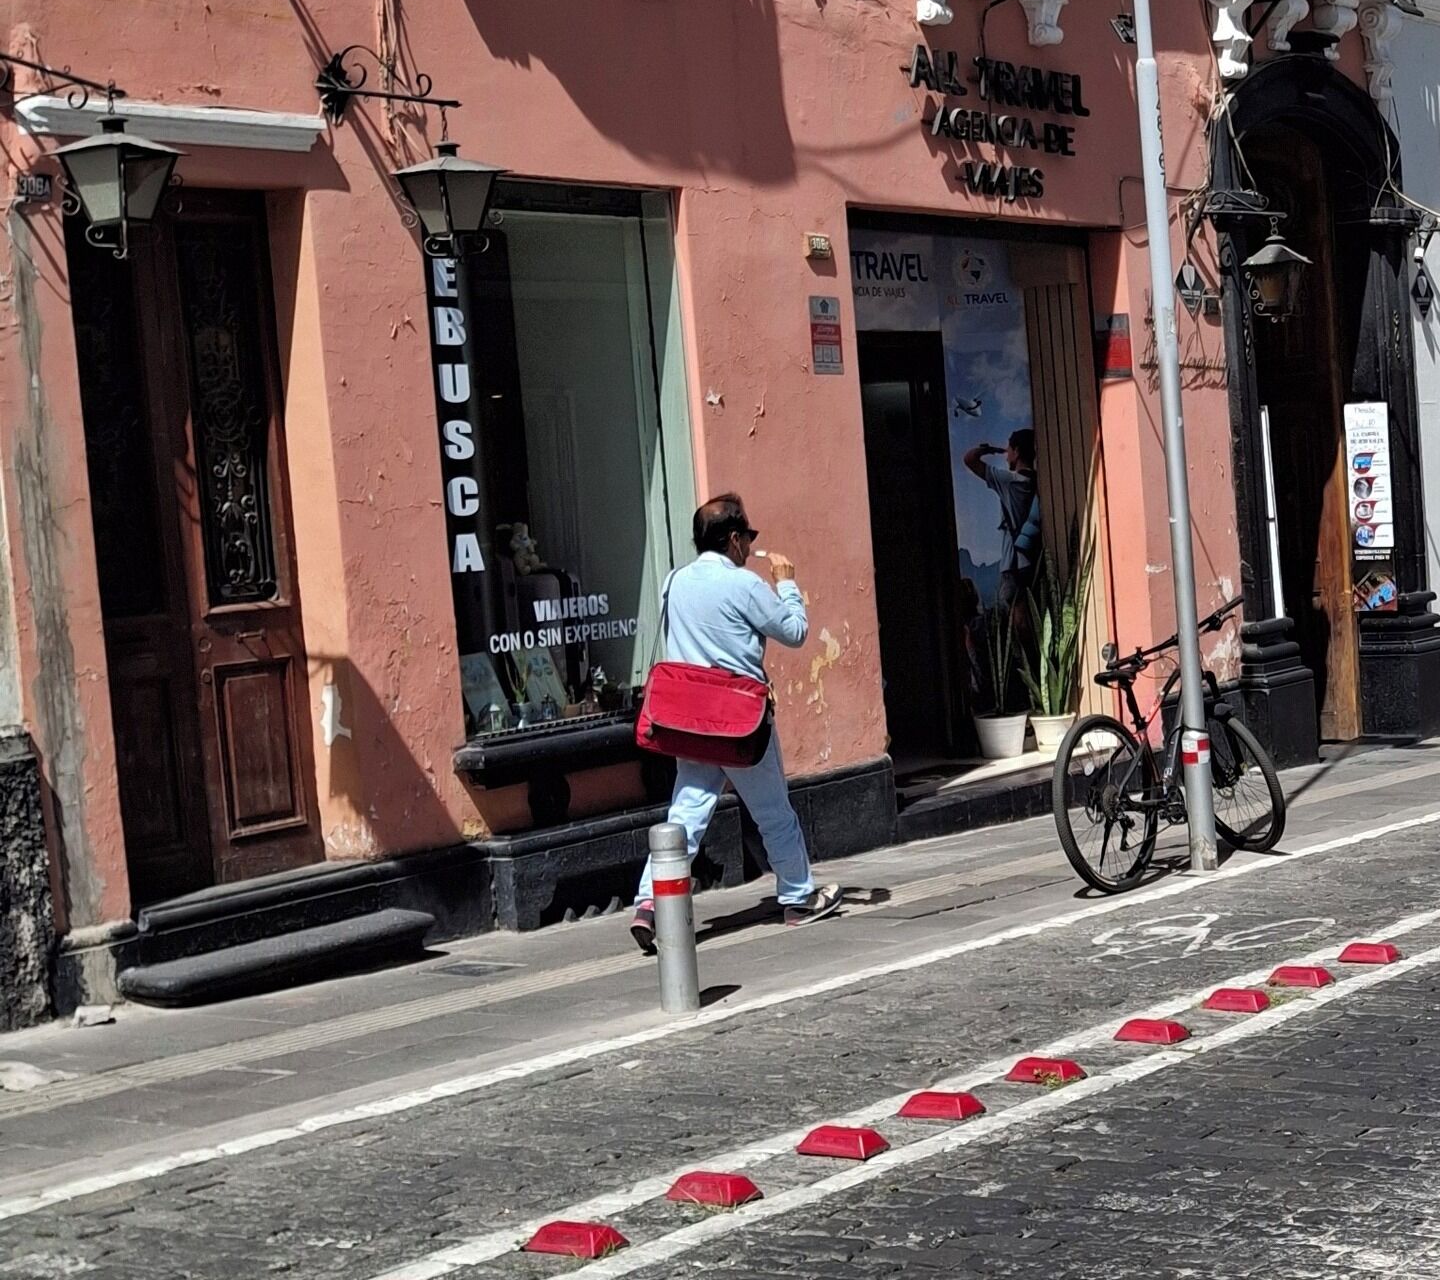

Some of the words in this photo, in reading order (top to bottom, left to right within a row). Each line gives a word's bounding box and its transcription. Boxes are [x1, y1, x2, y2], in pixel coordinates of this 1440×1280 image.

[910, 44, 967, 97] ALL
[973, 56, 1091, 117] TRAVEL
[931, 107, 1038, 150] AGENCIA
[1043, 123, 1076, 156] DE
[962, 160, 1044, 203] VIAJES
[851, 250, 928, 282] TRAVEL
[964, 292, 1009, 305] TRAVEL
[533, 593, 610, 623] VIAJEROS
[489, 633, 521, 654] CON
[523, 630, 535, 650] O
[538, 626, 562, 647] SIN
[565, 617, 645, 645] EXPERIENC
